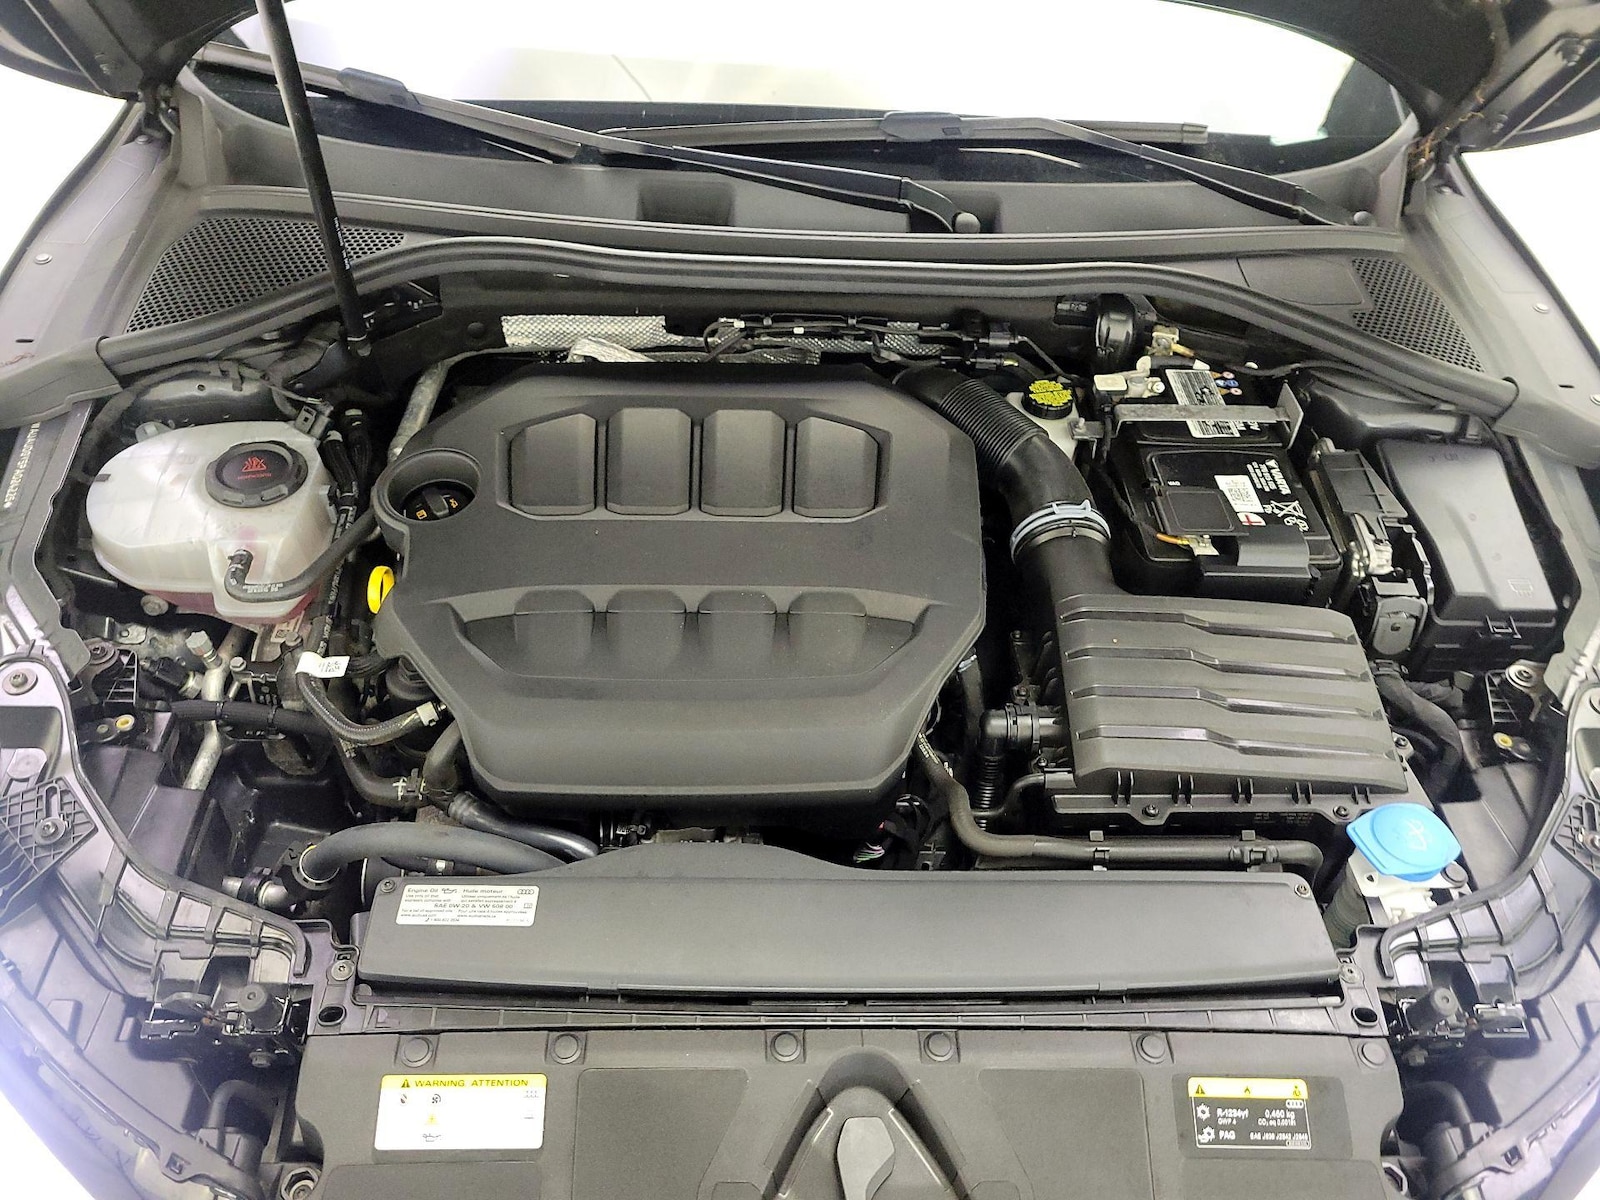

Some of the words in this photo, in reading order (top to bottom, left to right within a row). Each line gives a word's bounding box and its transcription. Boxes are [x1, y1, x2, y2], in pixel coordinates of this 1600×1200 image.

[1270, 468, 1292, 495] VARTA
[414, 1079, 465, 1088] WARNING
[471, 1079, 529, 1088] ATTENTION
[1216, 1108, 1249, 1119] R-1234yf
[1286, 1109, 1295, 1120] kg
[1219, 1130, 1236, 1140] PAG
